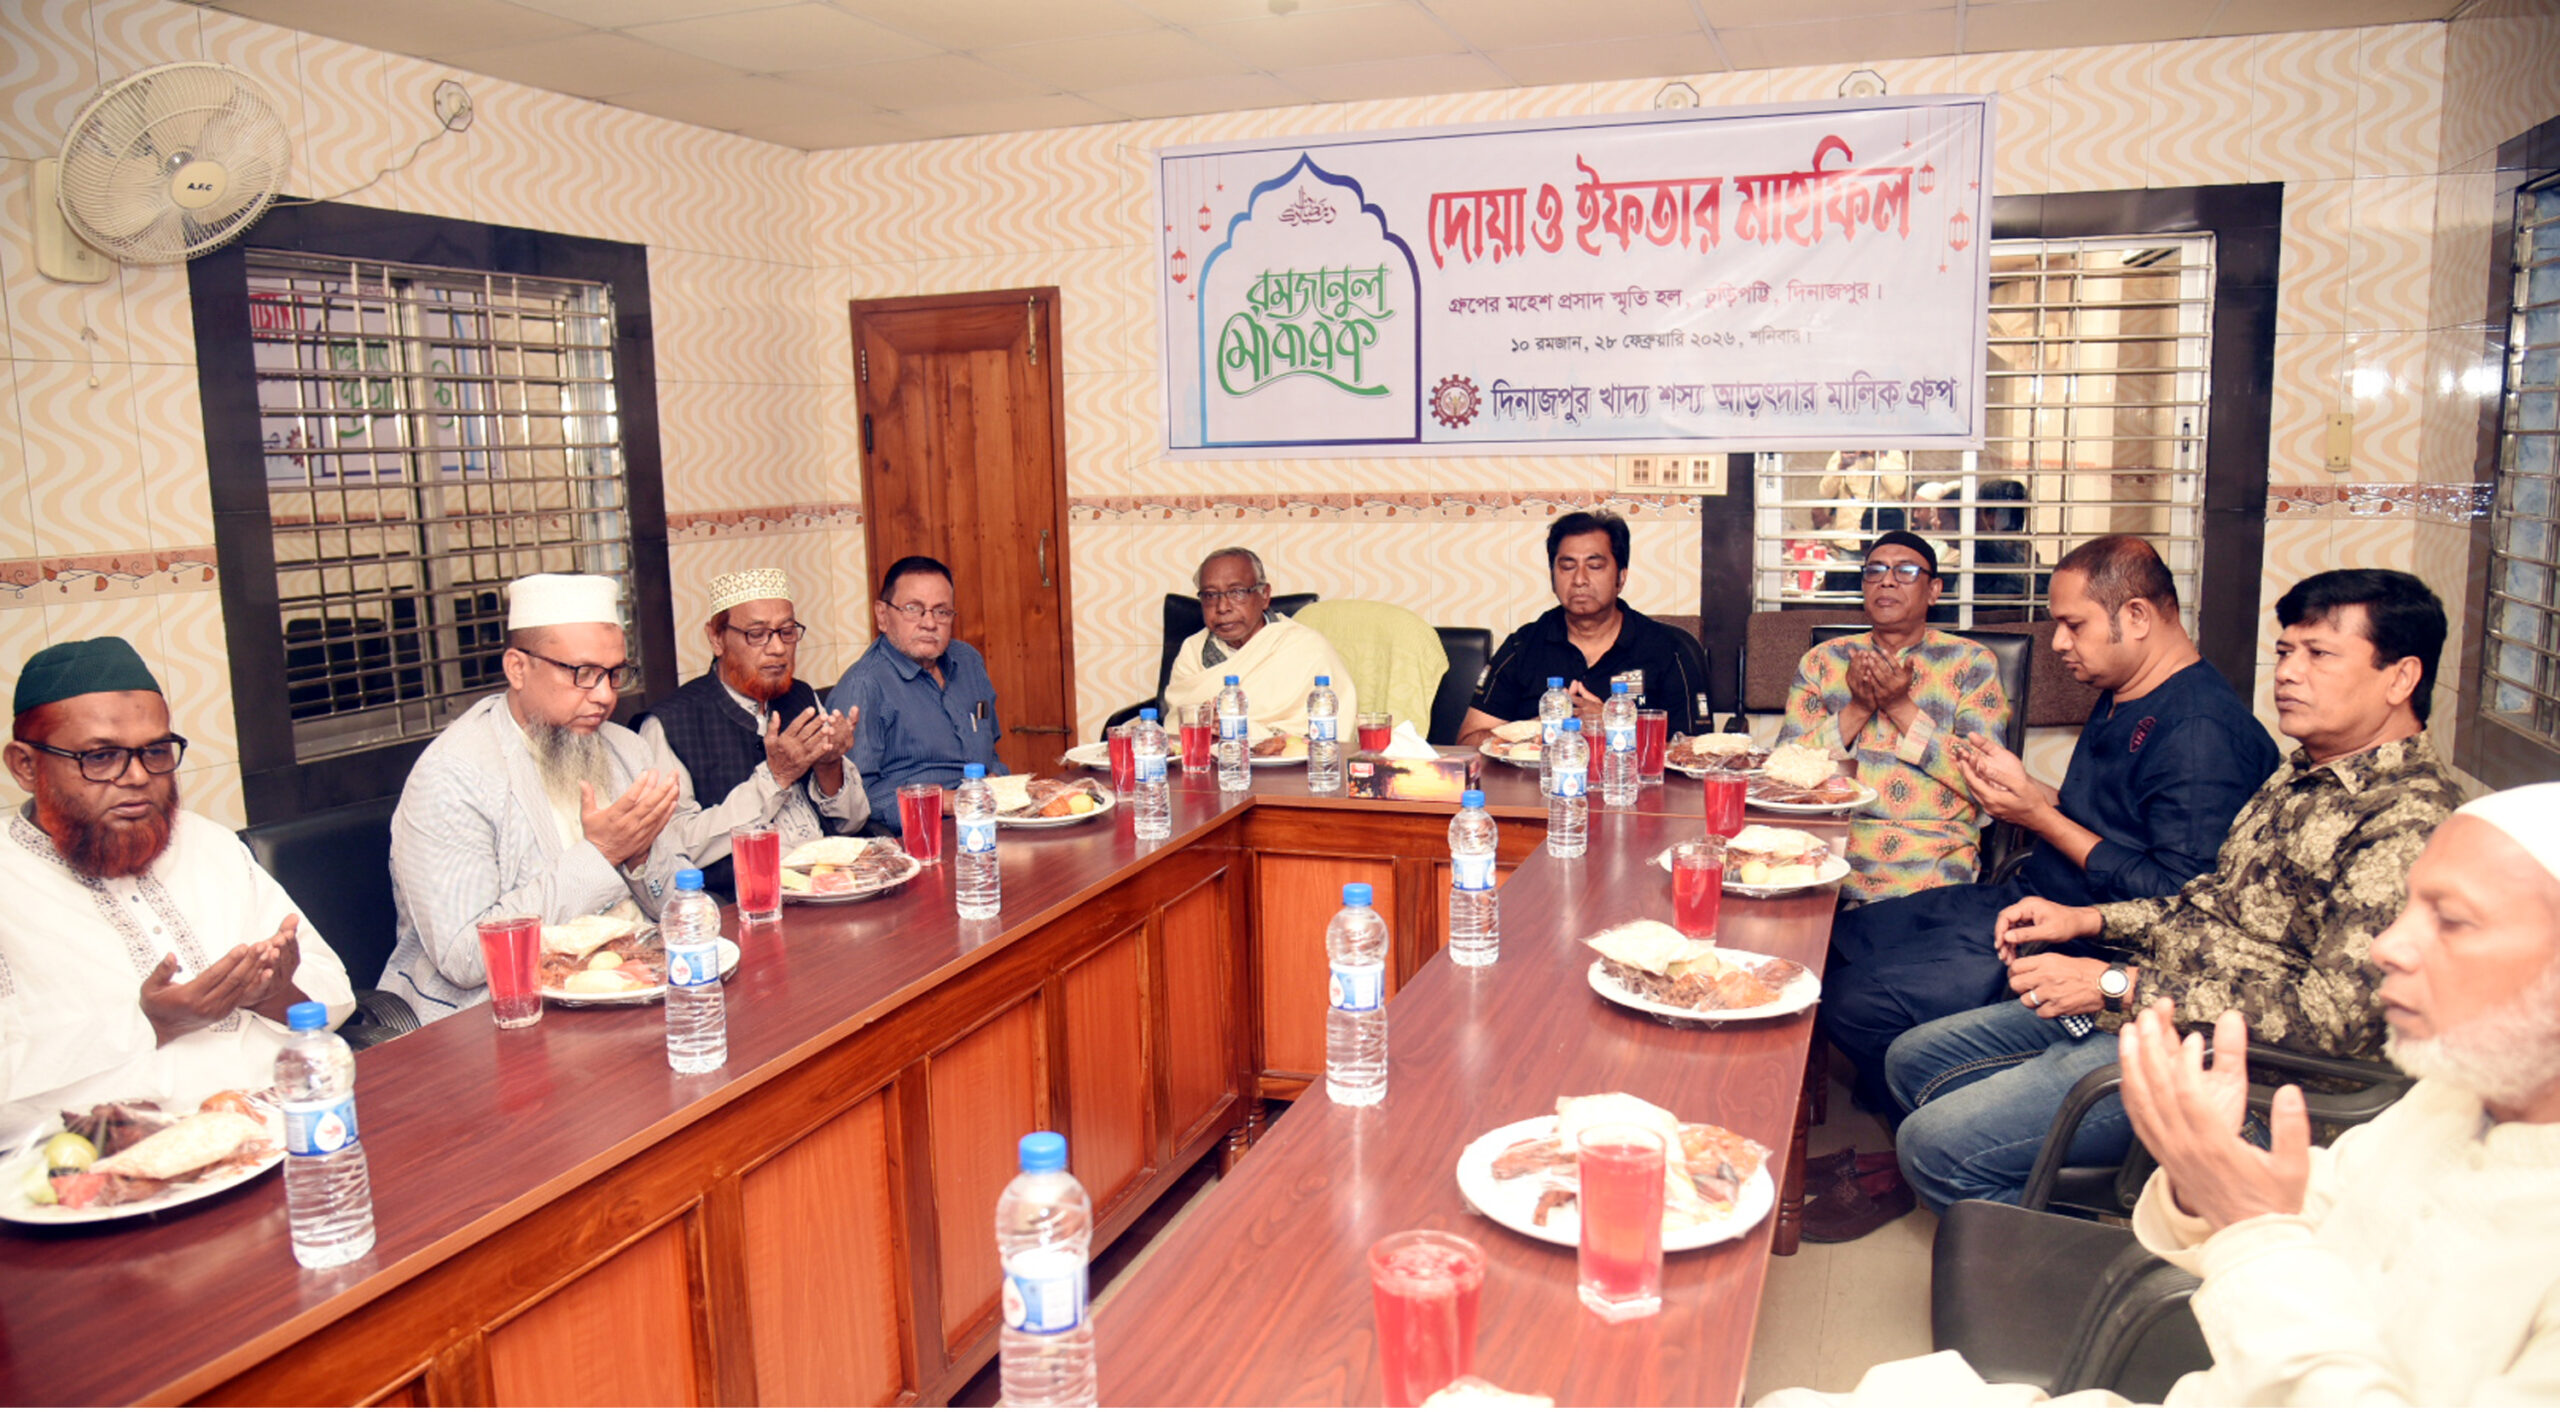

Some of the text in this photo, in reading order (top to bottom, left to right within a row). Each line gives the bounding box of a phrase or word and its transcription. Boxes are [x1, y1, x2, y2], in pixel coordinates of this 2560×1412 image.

[1428, 135, 1914, 270] দোয়া ও ইফতার মাহফিল
[1246, 263, 1394, 321] রমজানুল
[1448, 296, 1501, 314] গ্রুপের
[1506, 293, 1553, 312] মহেশ
[1557, 291, 1605, 311] প্রসাদ
[1610, 285, 1649, 315] স্মৃতি
[1218, 312, 1390, 395] মোবারক
[1511, 338, 1529, 353] ১০
[1594, 337, 1617, 350] ২৮
[1490, 378, 1592, 423] দিনাজপুর
[1599, 383, 1650, 414] খাদ্য
[1657, 383, 1705, 414] শস্য
[1712, 380, 1818, 418] আড়ৎদার
[1825, 370, 1902, 412] মালিক
[1907, 377, 1958, 412] গ্রুপ
